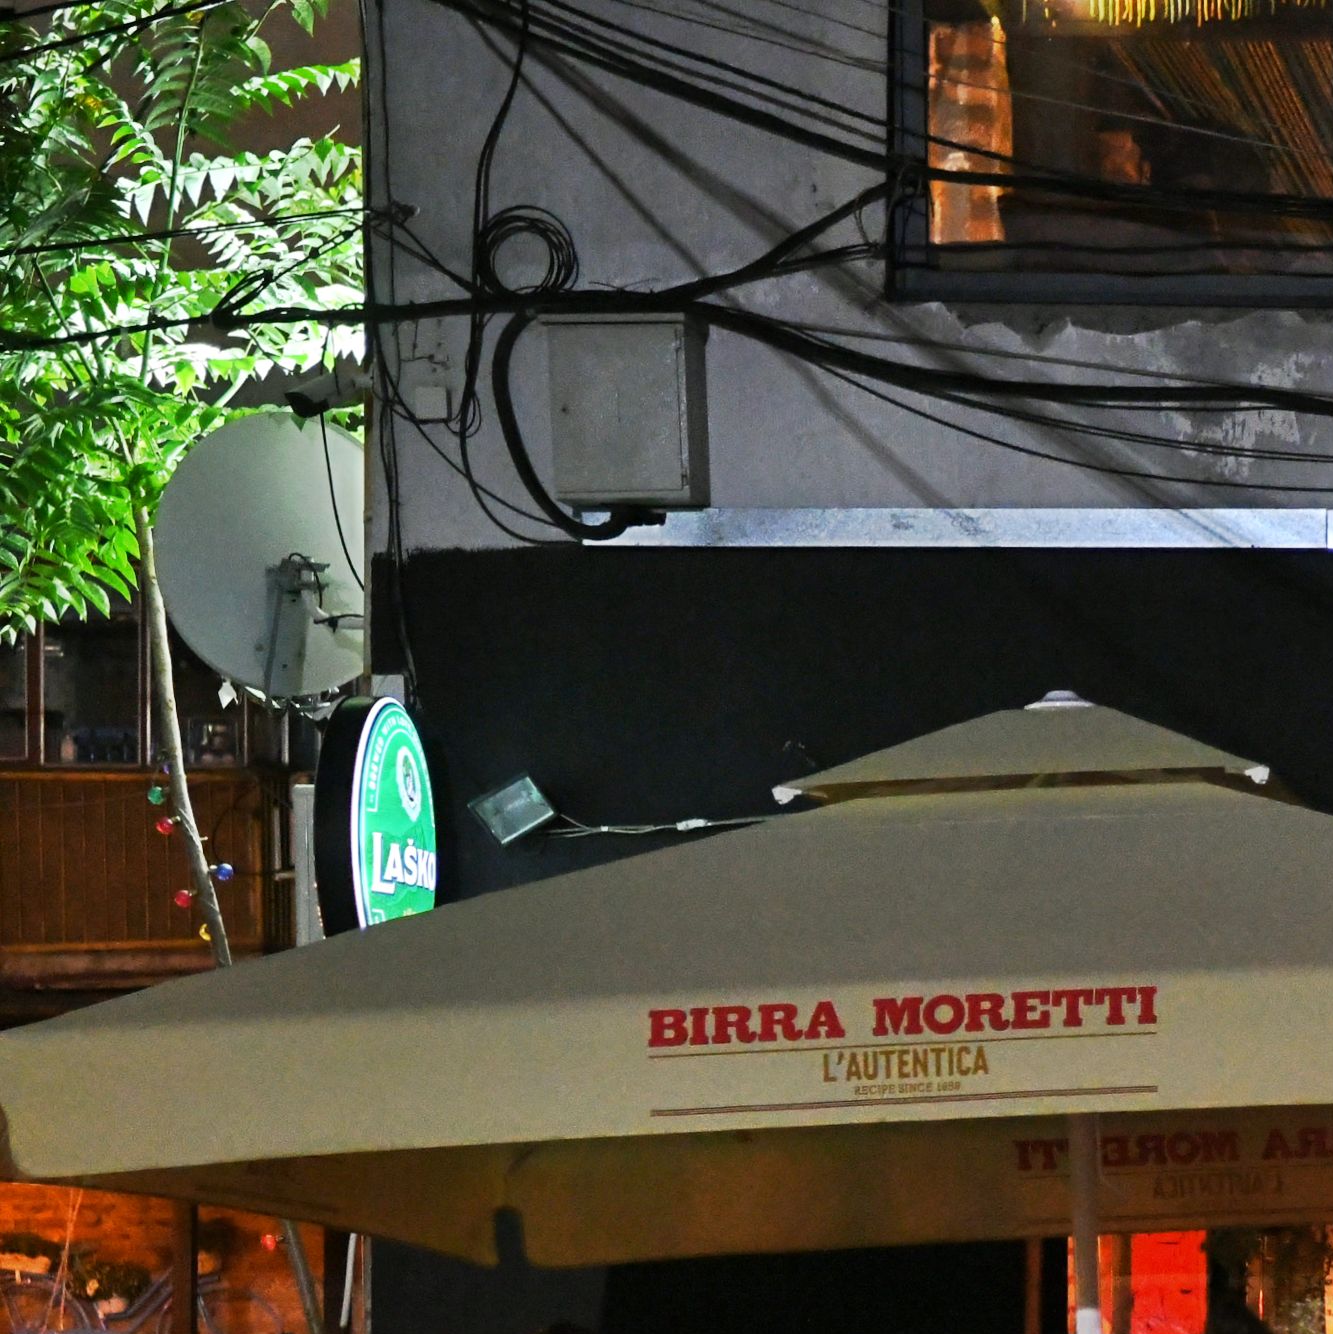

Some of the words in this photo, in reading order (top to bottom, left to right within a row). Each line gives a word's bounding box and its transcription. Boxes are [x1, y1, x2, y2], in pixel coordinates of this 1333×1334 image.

[371, 831, 436, 895] LAŠKO
[648, 1001, 846, 1048] BIRRA
[873, 986, 1158, 1037] MORETTI
[822, 1045, 990, 1083] L'AUTENTICA
[854, 1084, 896, 1096] RECIPE
[898, 1082, 932, 1094] SINCE
